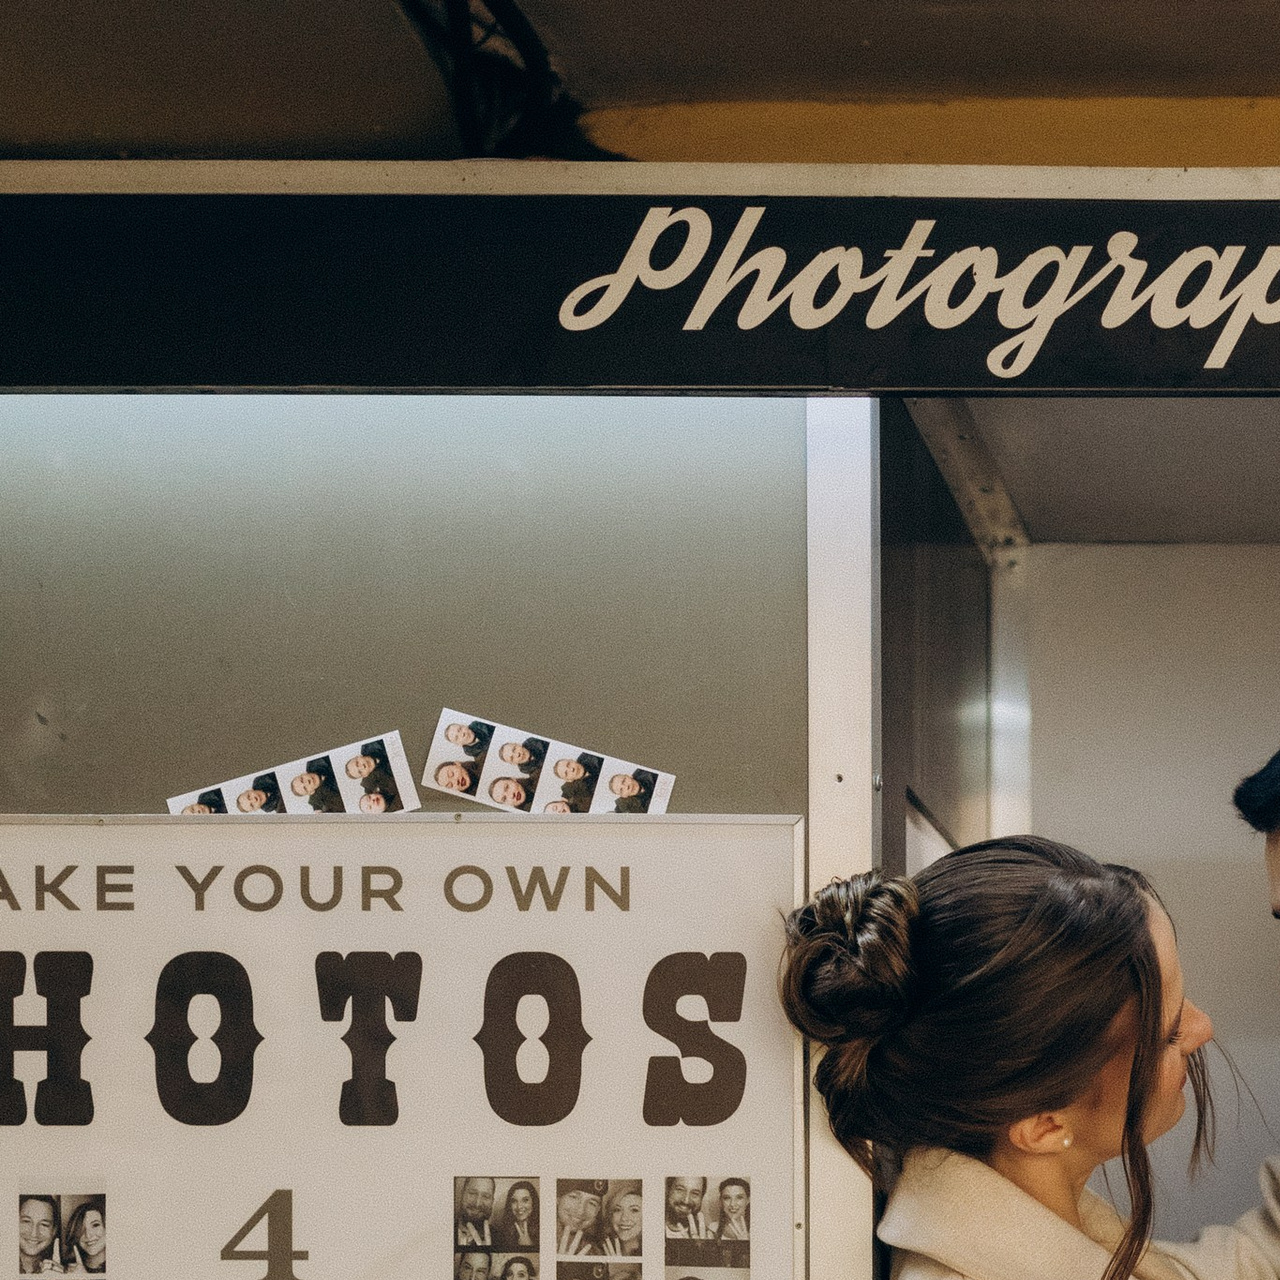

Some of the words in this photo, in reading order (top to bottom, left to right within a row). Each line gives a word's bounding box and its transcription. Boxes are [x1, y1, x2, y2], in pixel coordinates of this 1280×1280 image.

[176, 865, 403, 912] YOUR
[444, 865, 632, 912] OWN
[0, 951, 747, 1126] HOTOS
